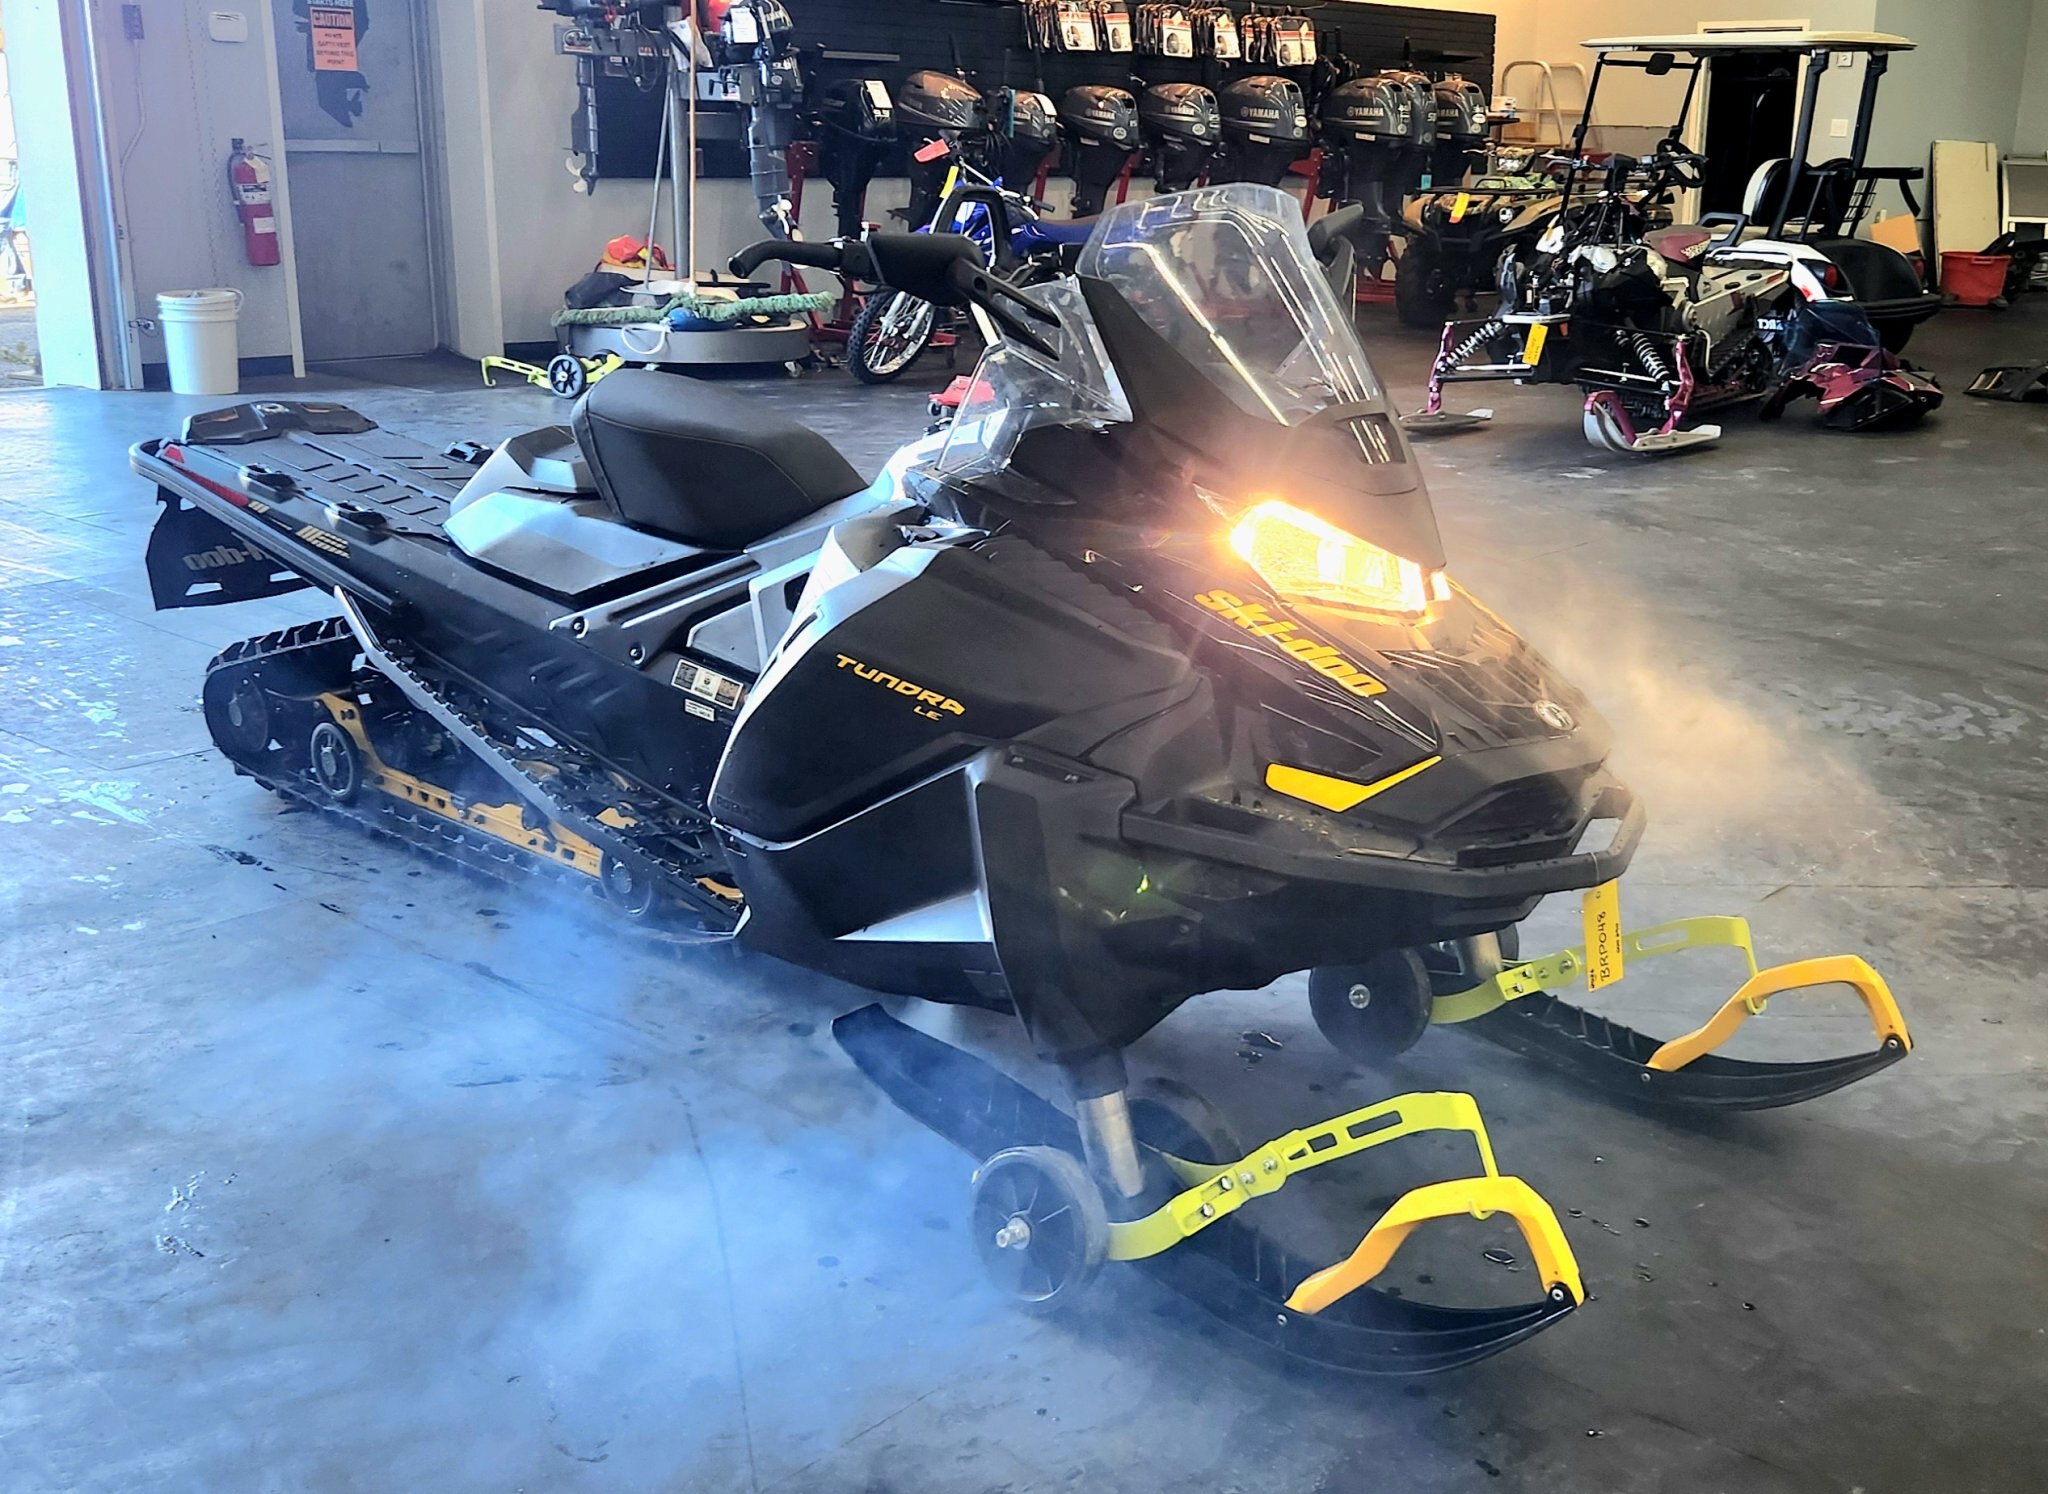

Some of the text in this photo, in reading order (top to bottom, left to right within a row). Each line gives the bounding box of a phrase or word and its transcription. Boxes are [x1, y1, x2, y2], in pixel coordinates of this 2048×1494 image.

[312, 12, 352, 27] CAUTION
[1249, 107, 1280, 119] YAMAHA
[1354, 107, 1384, 117] YAMAHA
[836, 654, 966, 716] TUNDRA
[913, 705, 944, 721] LE
[1596, 911, 1610, 982] BRP048
